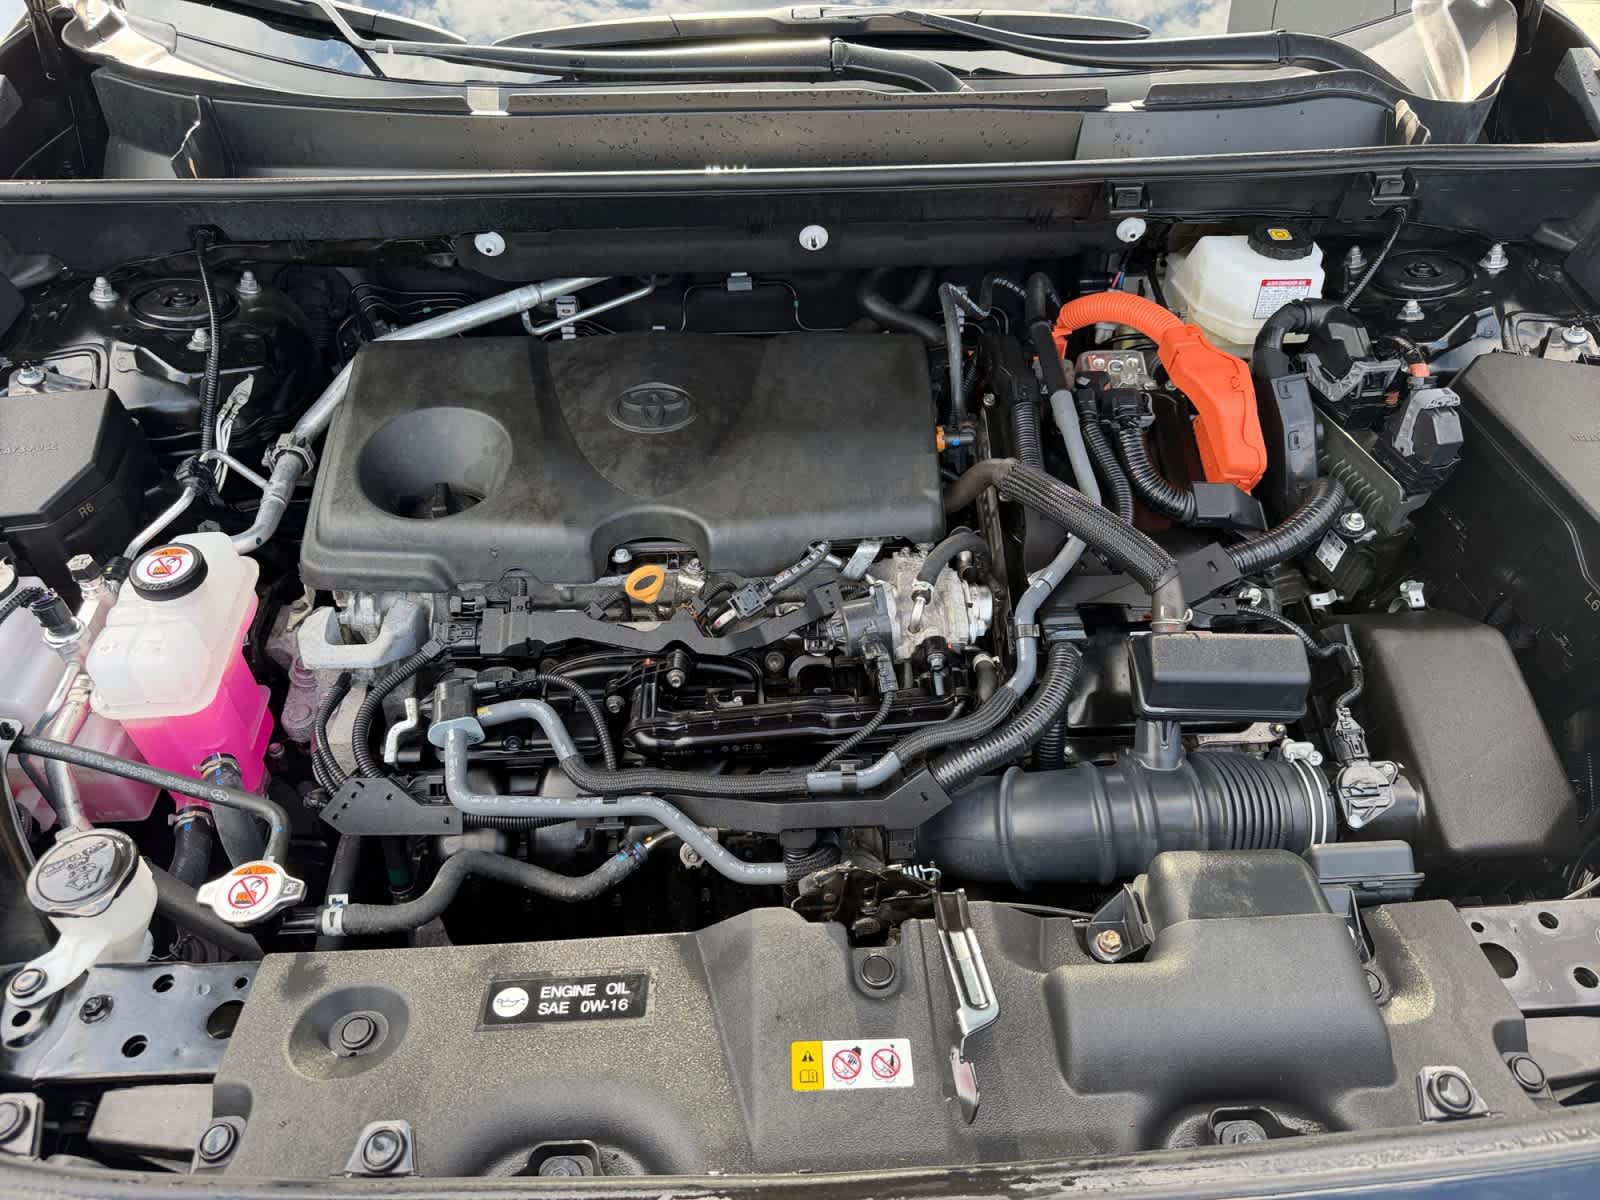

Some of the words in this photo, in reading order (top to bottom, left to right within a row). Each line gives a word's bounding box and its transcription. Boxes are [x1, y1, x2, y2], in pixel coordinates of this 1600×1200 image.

[540, 983, 597, 999] ENGINE
[605, 982, 630, 995] OIL
[537, 1001, 570, 1015] SAE
[580, 998, 629, 1013] 0W-16
